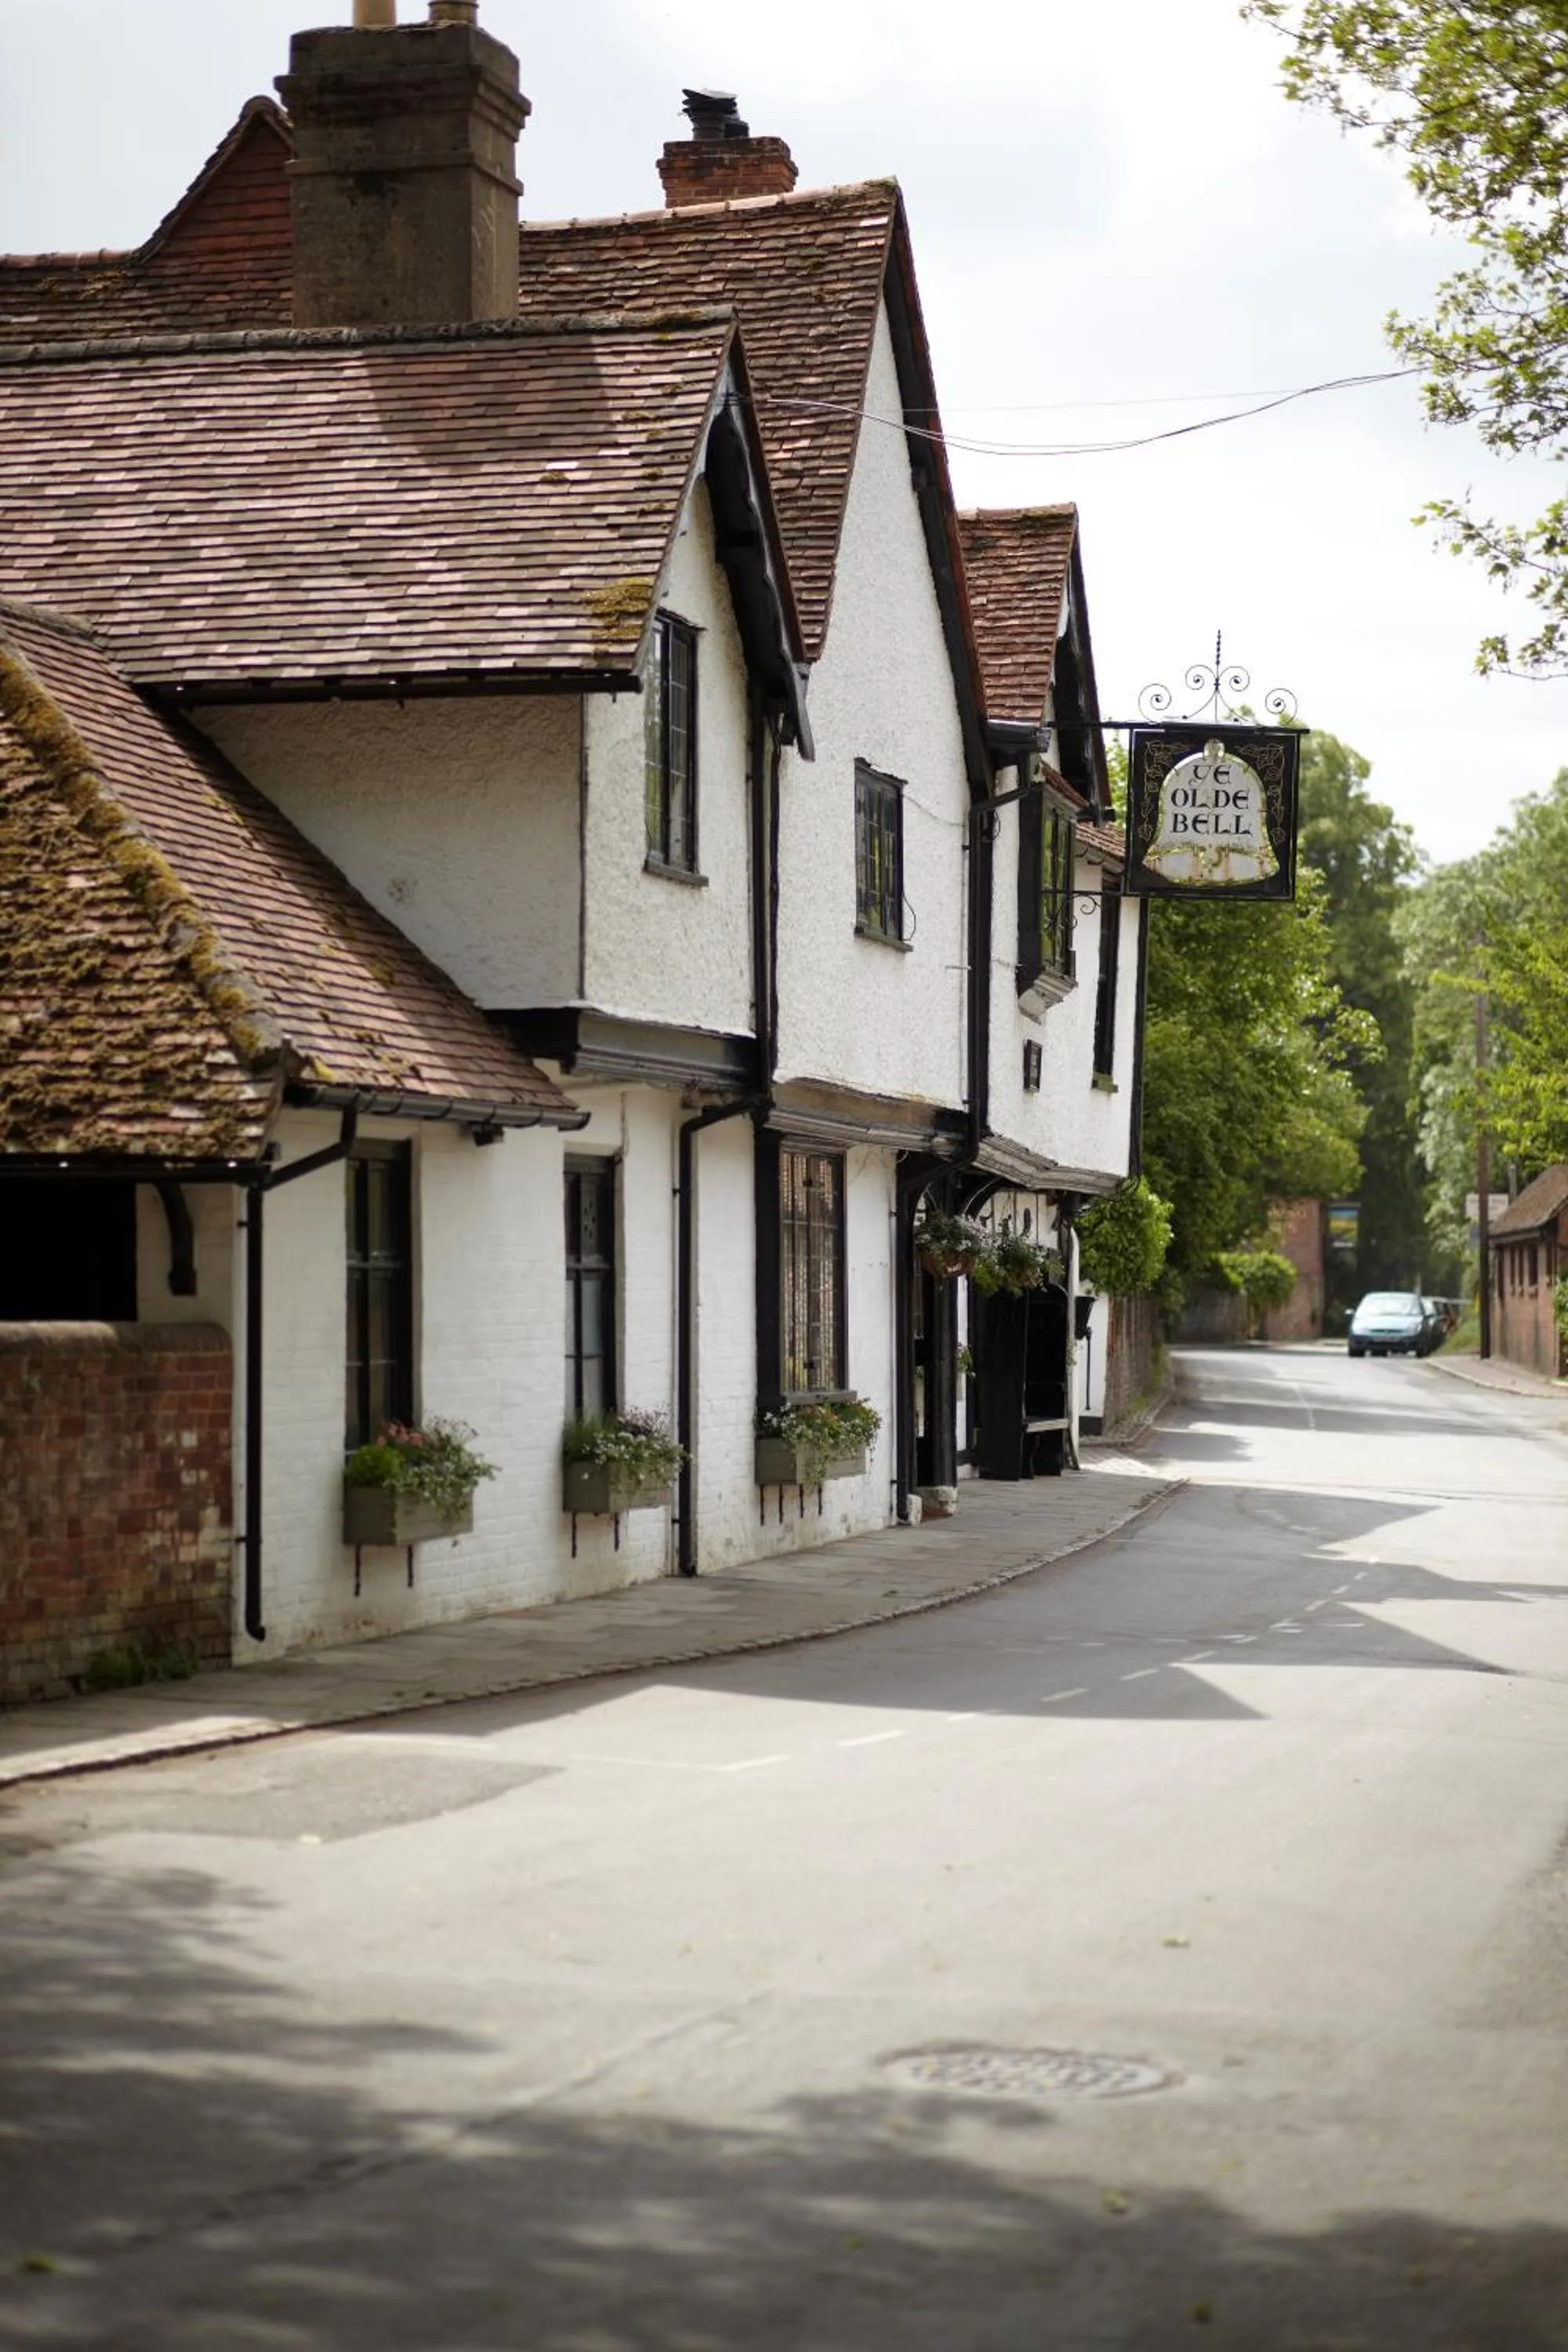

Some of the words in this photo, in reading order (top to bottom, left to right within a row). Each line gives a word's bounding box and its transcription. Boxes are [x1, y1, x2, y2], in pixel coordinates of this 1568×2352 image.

[1189, 764, 1230, 786] YE
[1171, 788, 1249, 809] OLDE
[1171, 813, 1253, 836] BELL
